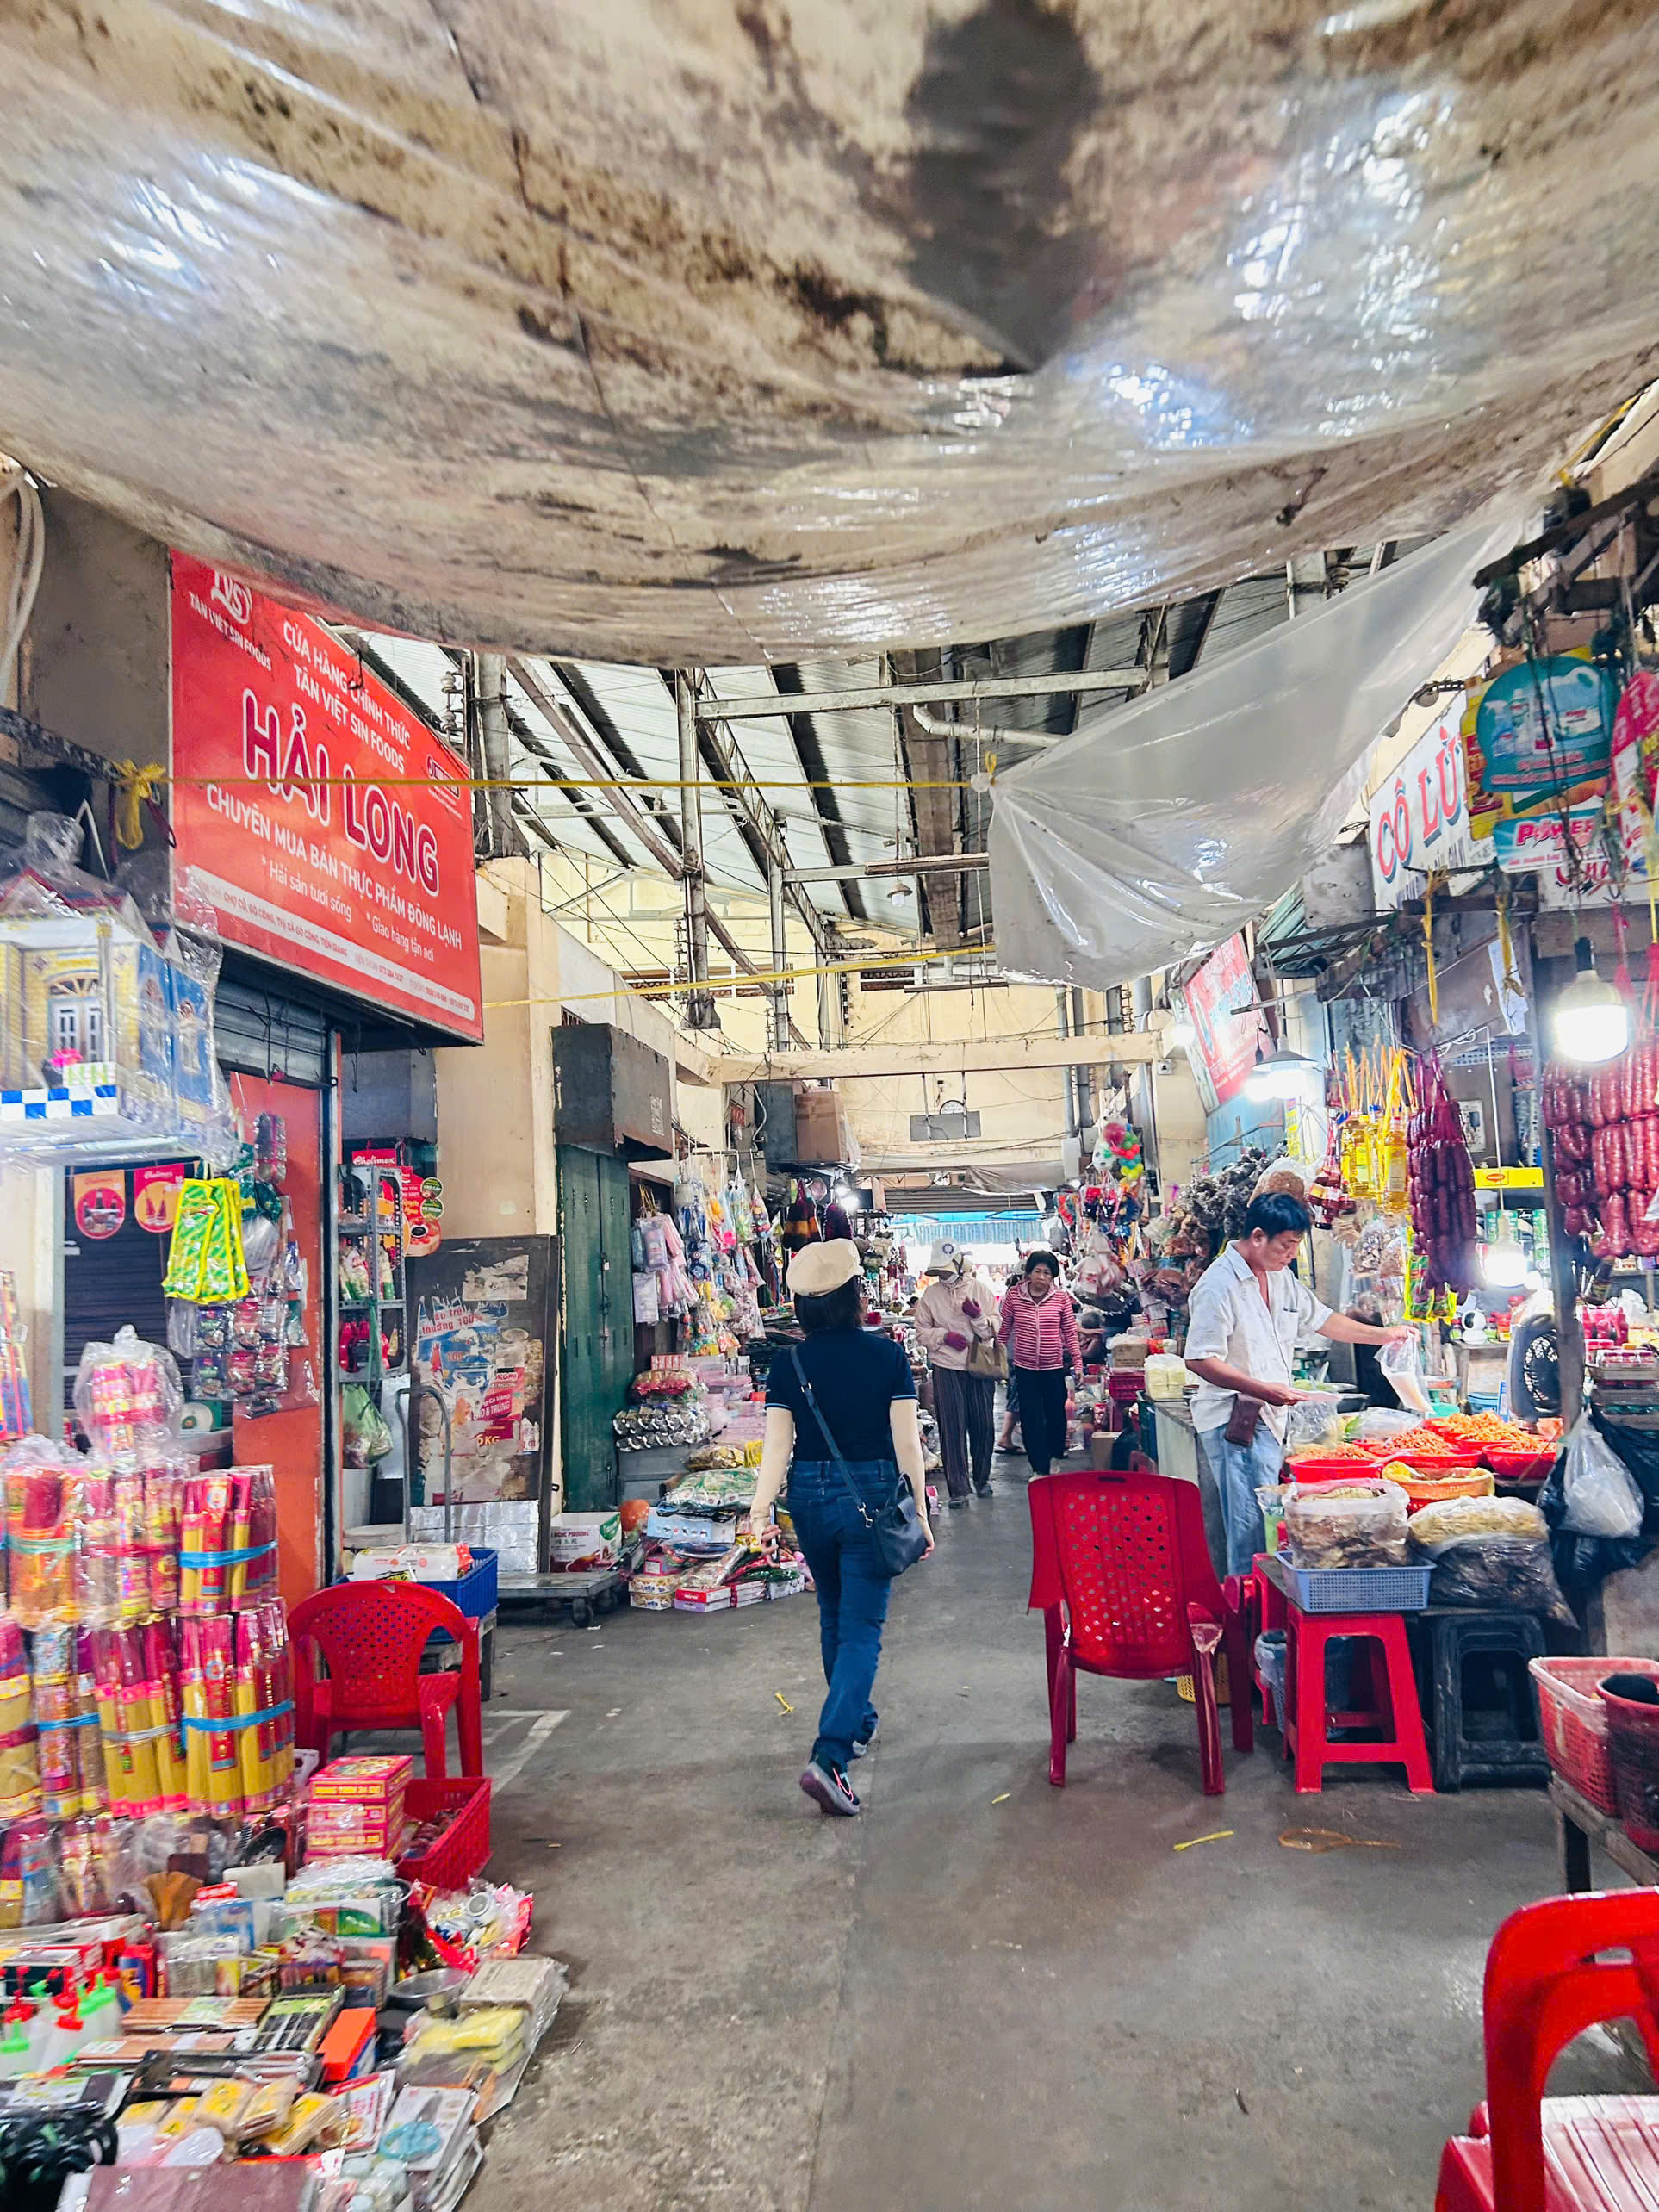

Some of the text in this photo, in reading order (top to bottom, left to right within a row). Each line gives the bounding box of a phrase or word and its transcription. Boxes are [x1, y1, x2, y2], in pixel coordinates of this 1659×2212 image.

[244, 637, 272, 672] FOODS
[283, 619, 411, 750] CỬA HÀNG CHÍNH THỨC
[294, 663, 405, 774] TÂN VIỆT SIN FOODS
[243, 688, 439, 897] HẢI LONG
[1378, 777, 1412, 884] CÔ
[207, 785, 463, 951] CHUYÊN MUA BÁN THỰC PHẨM ĐÔNG LẠNH
[309, 883, 328, 907] tươi
[330, 894, 353, 924] sống
[371, 916, 435, 963] Giao hàng tận nơi
[353, 1155, 395, 1165] Cholimex
